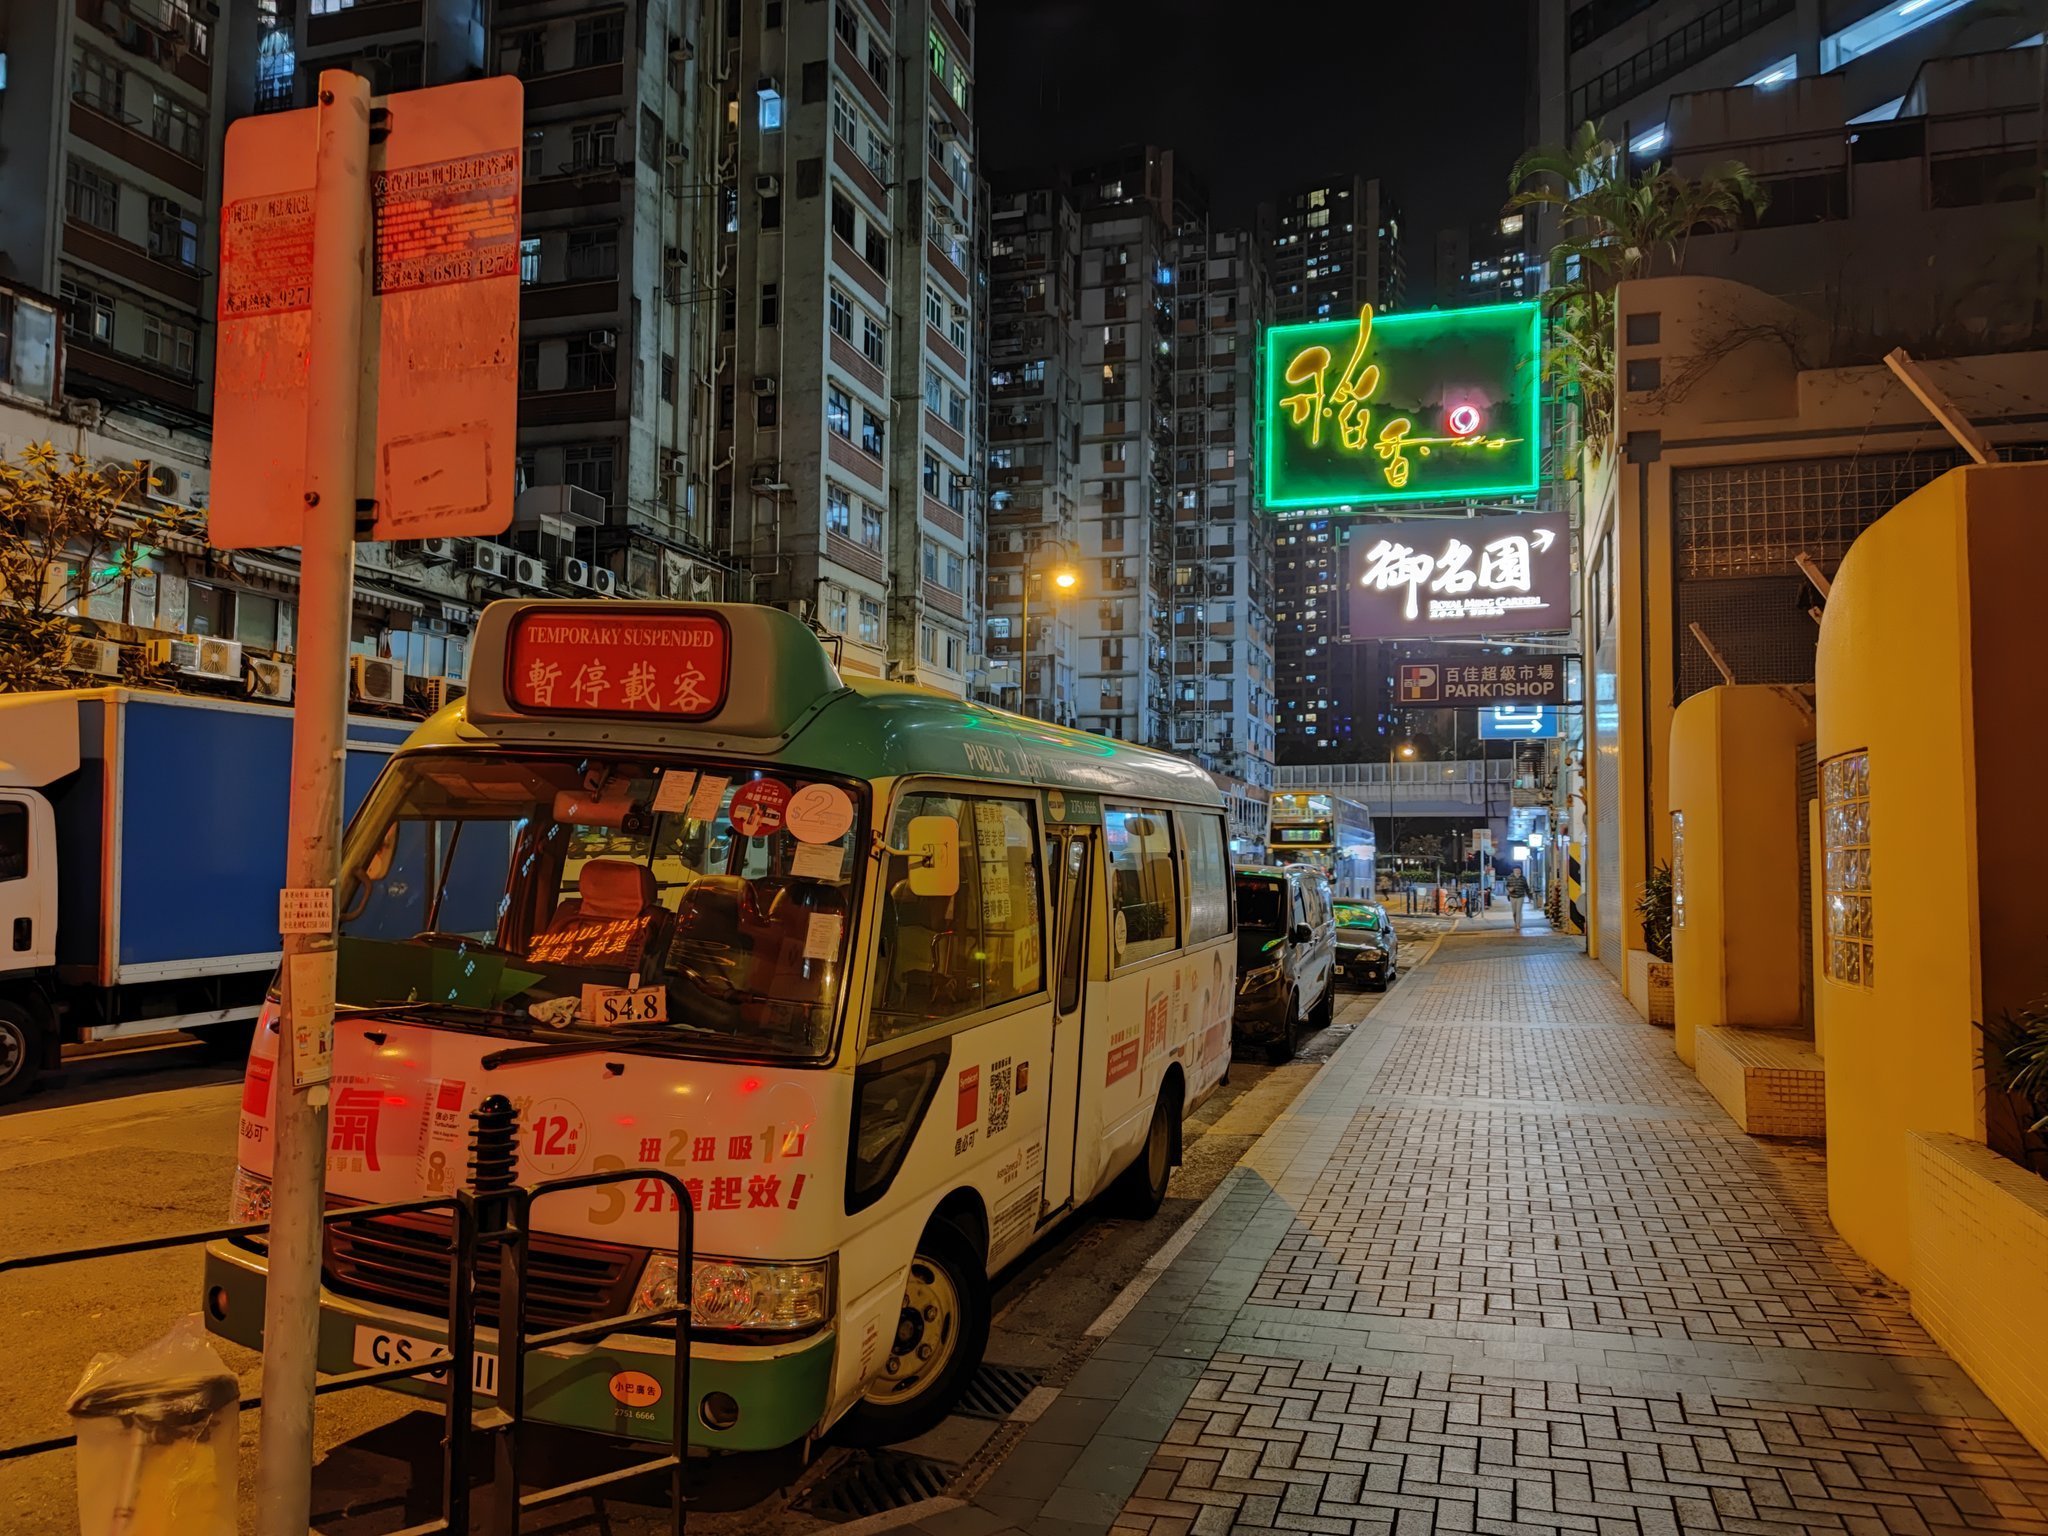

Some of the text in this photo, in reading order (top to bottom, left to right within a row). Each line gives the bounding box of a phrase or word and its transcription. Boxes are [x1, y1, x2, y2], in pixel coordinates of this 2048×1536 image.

[1362, 535, 1531, 619] 御名園
[528, 626, 714, 647] TEMPORARY SUSPENDED
[526, 658, 711, 712] 暫停載客
[1445, 664, 1555, 683] 百佳超級市場
[1445, 682, 1555, 698] PARKnSHOP
[963, 742, 1010, 774] PUBLIC
[1013, 751, 1047, 779] LIGHT
[1018, 933, 1039, 973] 12B
[604, 994, 658, 1023] $4.8
[331, 1087, 384, 1172] 氣
[532, 1116, 568, 1155] 12
[955, 1131, 976, 1157] 信必可
[372, 1335, 412, 1365] GS
[614, 1381, 657, 1397] 小巴廣告
[614, 1408, 656, 1421] 2751 6666
